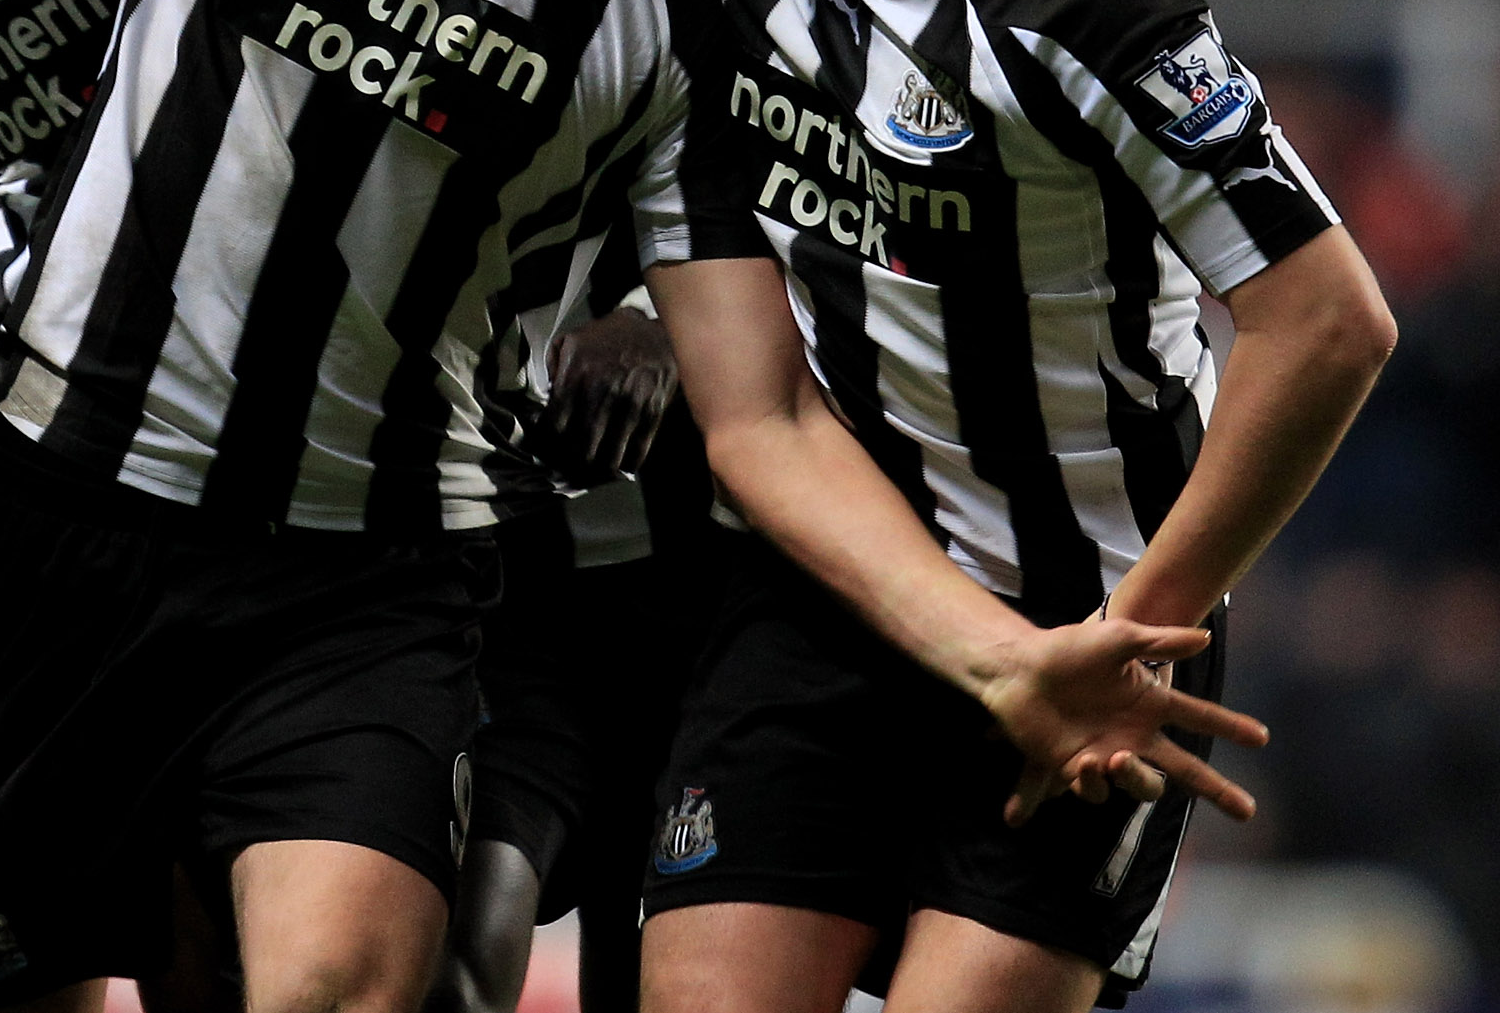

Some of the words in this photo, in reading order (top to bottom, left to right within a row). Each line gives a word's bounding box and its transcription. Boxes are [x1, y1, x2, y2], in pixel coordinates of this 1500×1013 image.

[274, 2, 448, 134] rock.
[1181, 88, 1233, 134] BARCLAYS
[730, 70, 971, 232] northern
